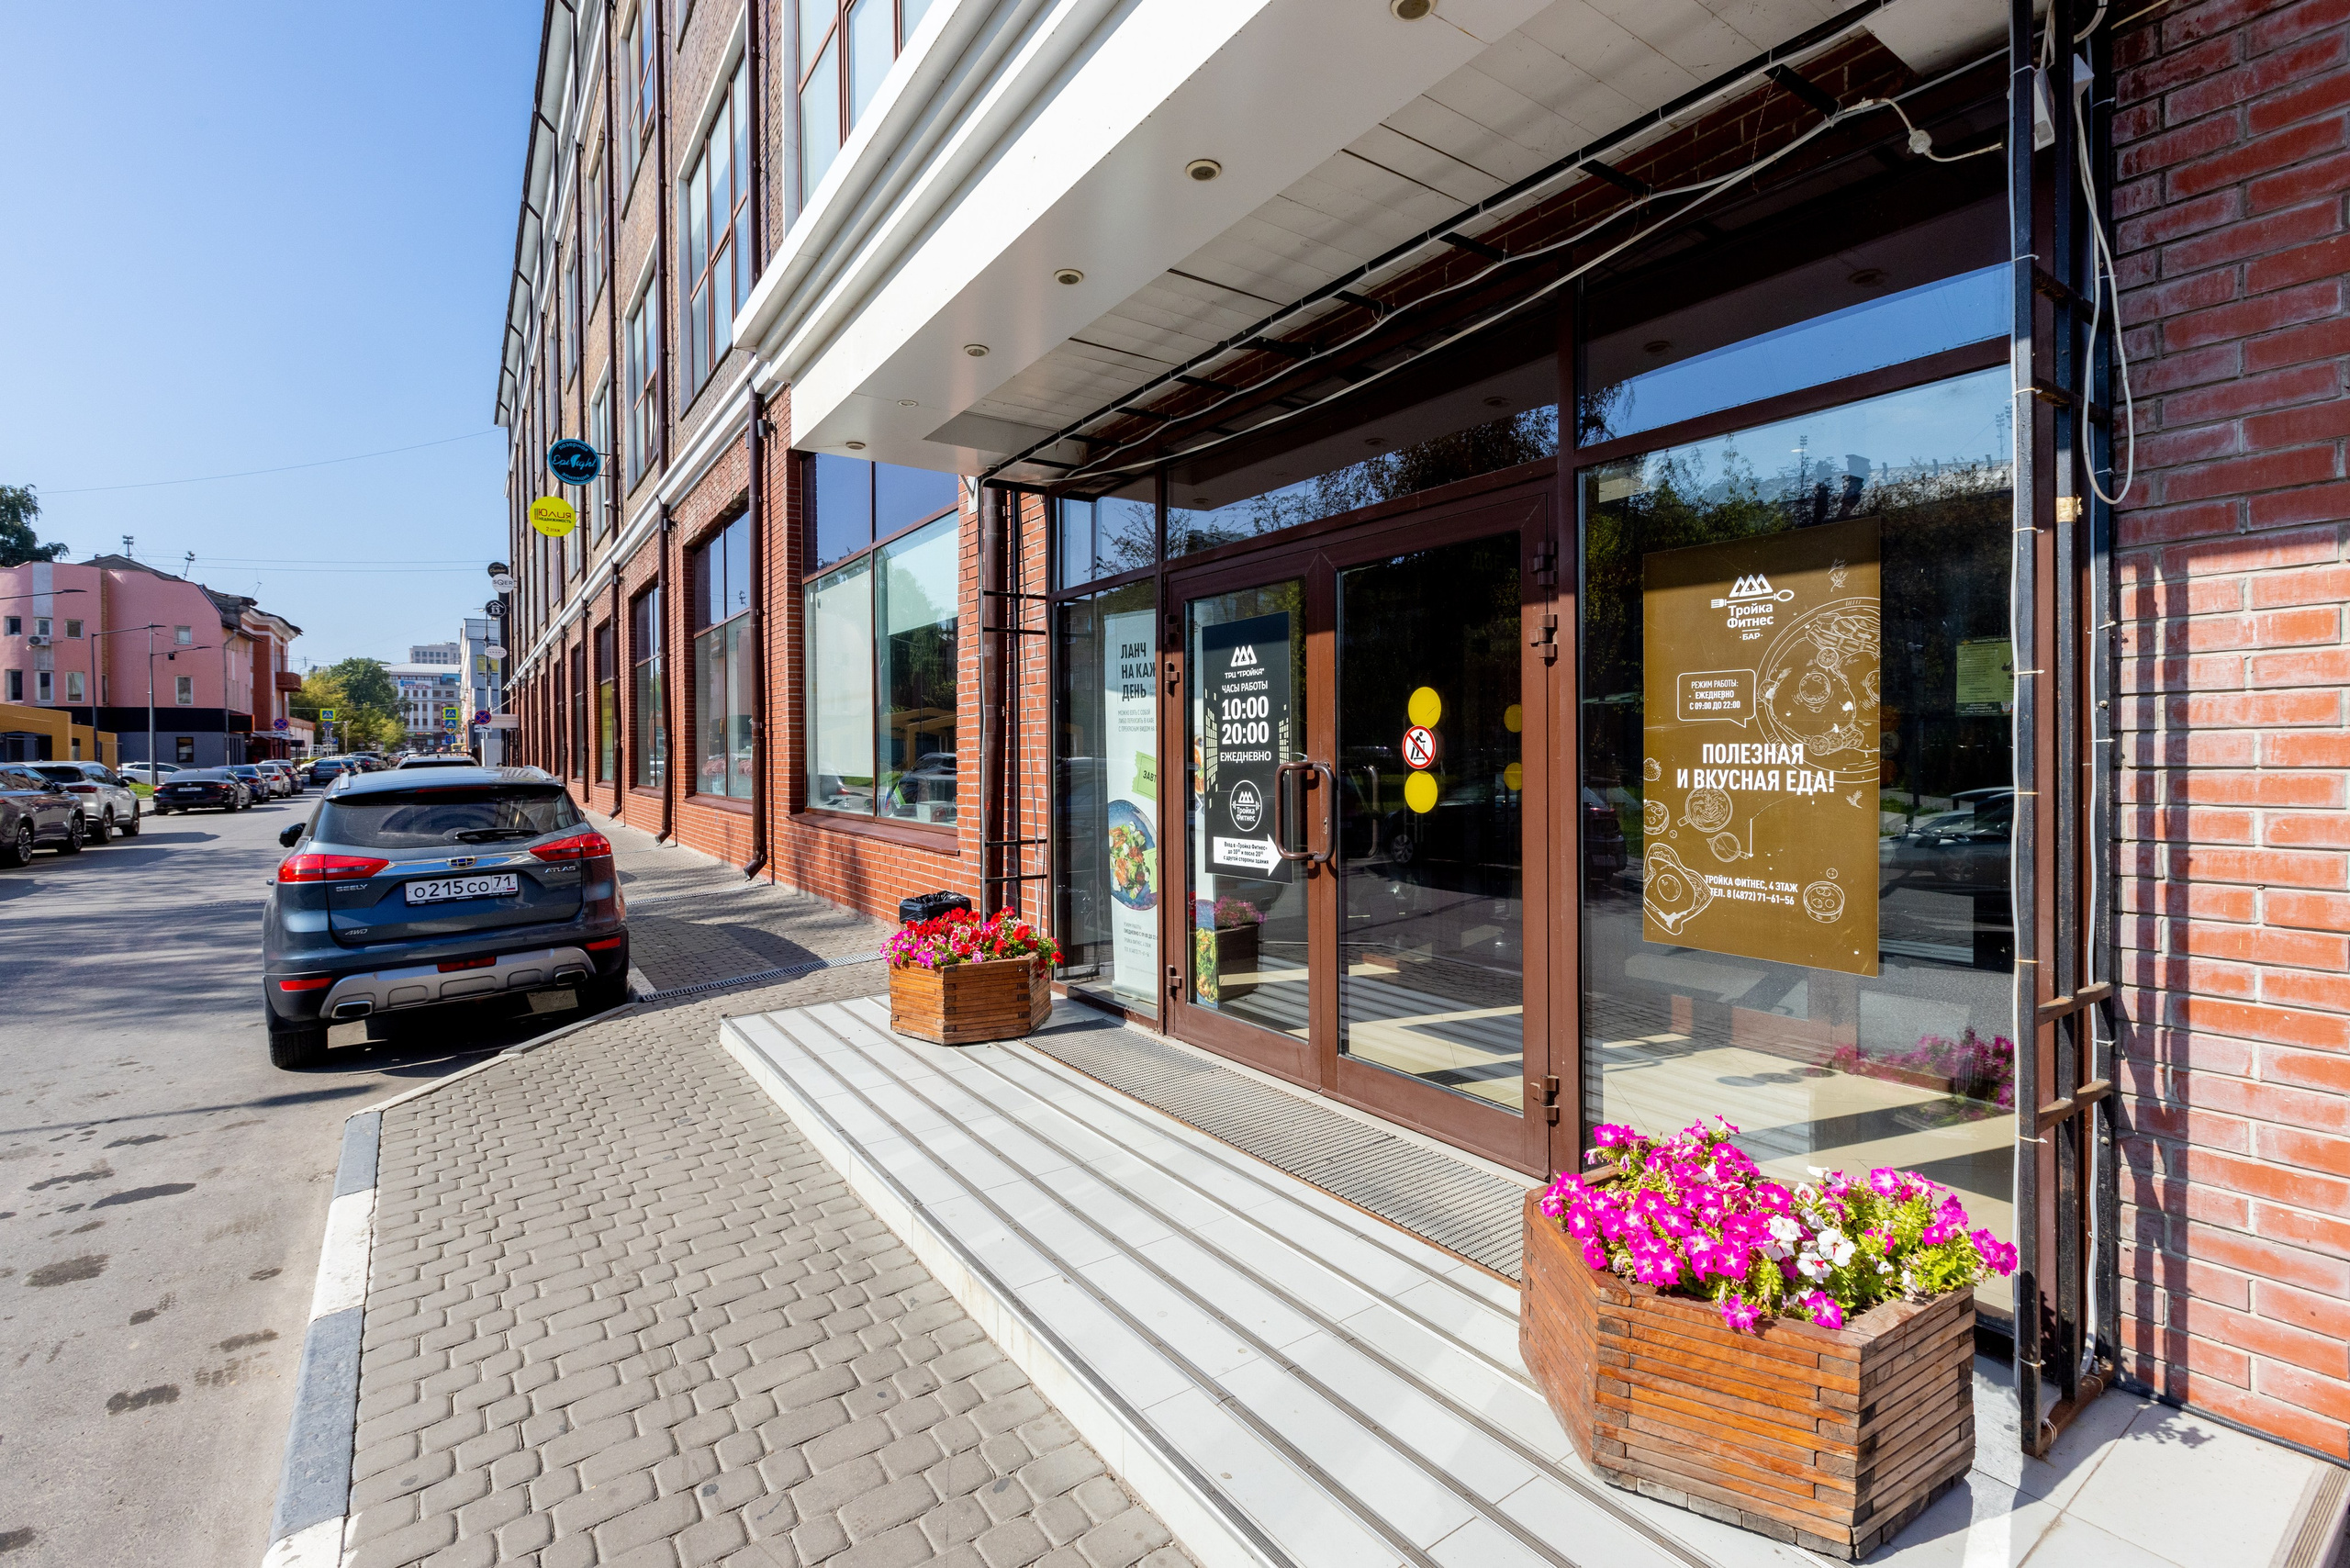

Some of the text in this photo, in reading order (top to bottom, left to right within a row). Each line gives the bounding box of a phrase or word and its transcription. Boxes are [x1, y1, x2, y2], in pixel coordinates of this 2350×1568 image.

[1728, 602, 1773, 618] Тройка
[1727, 616, 1774, 628] Фитнес
[1121, 642, 1147, 659] ЛАНЧ
[1121, 663, 1135, 679] НА
[1225, 671, 1237, 679] ТРЦ
[1221, 680, 1269, 693] ЧАСЫ РАБОТЫ
[1691, 678, 1739, 689] РЕЖИМ РАБОТЫ:
[1122, 683, 1147, 701] ДЕНЬ
[1695, 689, 1735, 700] ЕЖЕДНЕВНО
[1221, 696, 1270, 721] 10:00
[1689, 700, 1740, 711] С 09:00 ДО 22:00
[1221, 721, 1270, 745] 20:00
[1220, 751, 1271, 763] ЕЖЕДНЕВНО
[1702, 743, 1804, 765] ПОЛЕЗНАЯ
[1676, 768, 1835, 796] И ВКУСНАЯ ЕДА!
[1236, 806, 1256, 815] Тройка
[1236, 813, 1256, 822] Фитнес
[335, 883, 368, 892] GEELY
[1705, 874, 1798, 893] ТРОЙКА ФИТНЕС, 4 ЭТАЖ
[1710, 887, 1726, 898] ТЕЛ.
[1727, 889, 1731, 898] 8
[1732, 889, 1756, 902] (4872)
